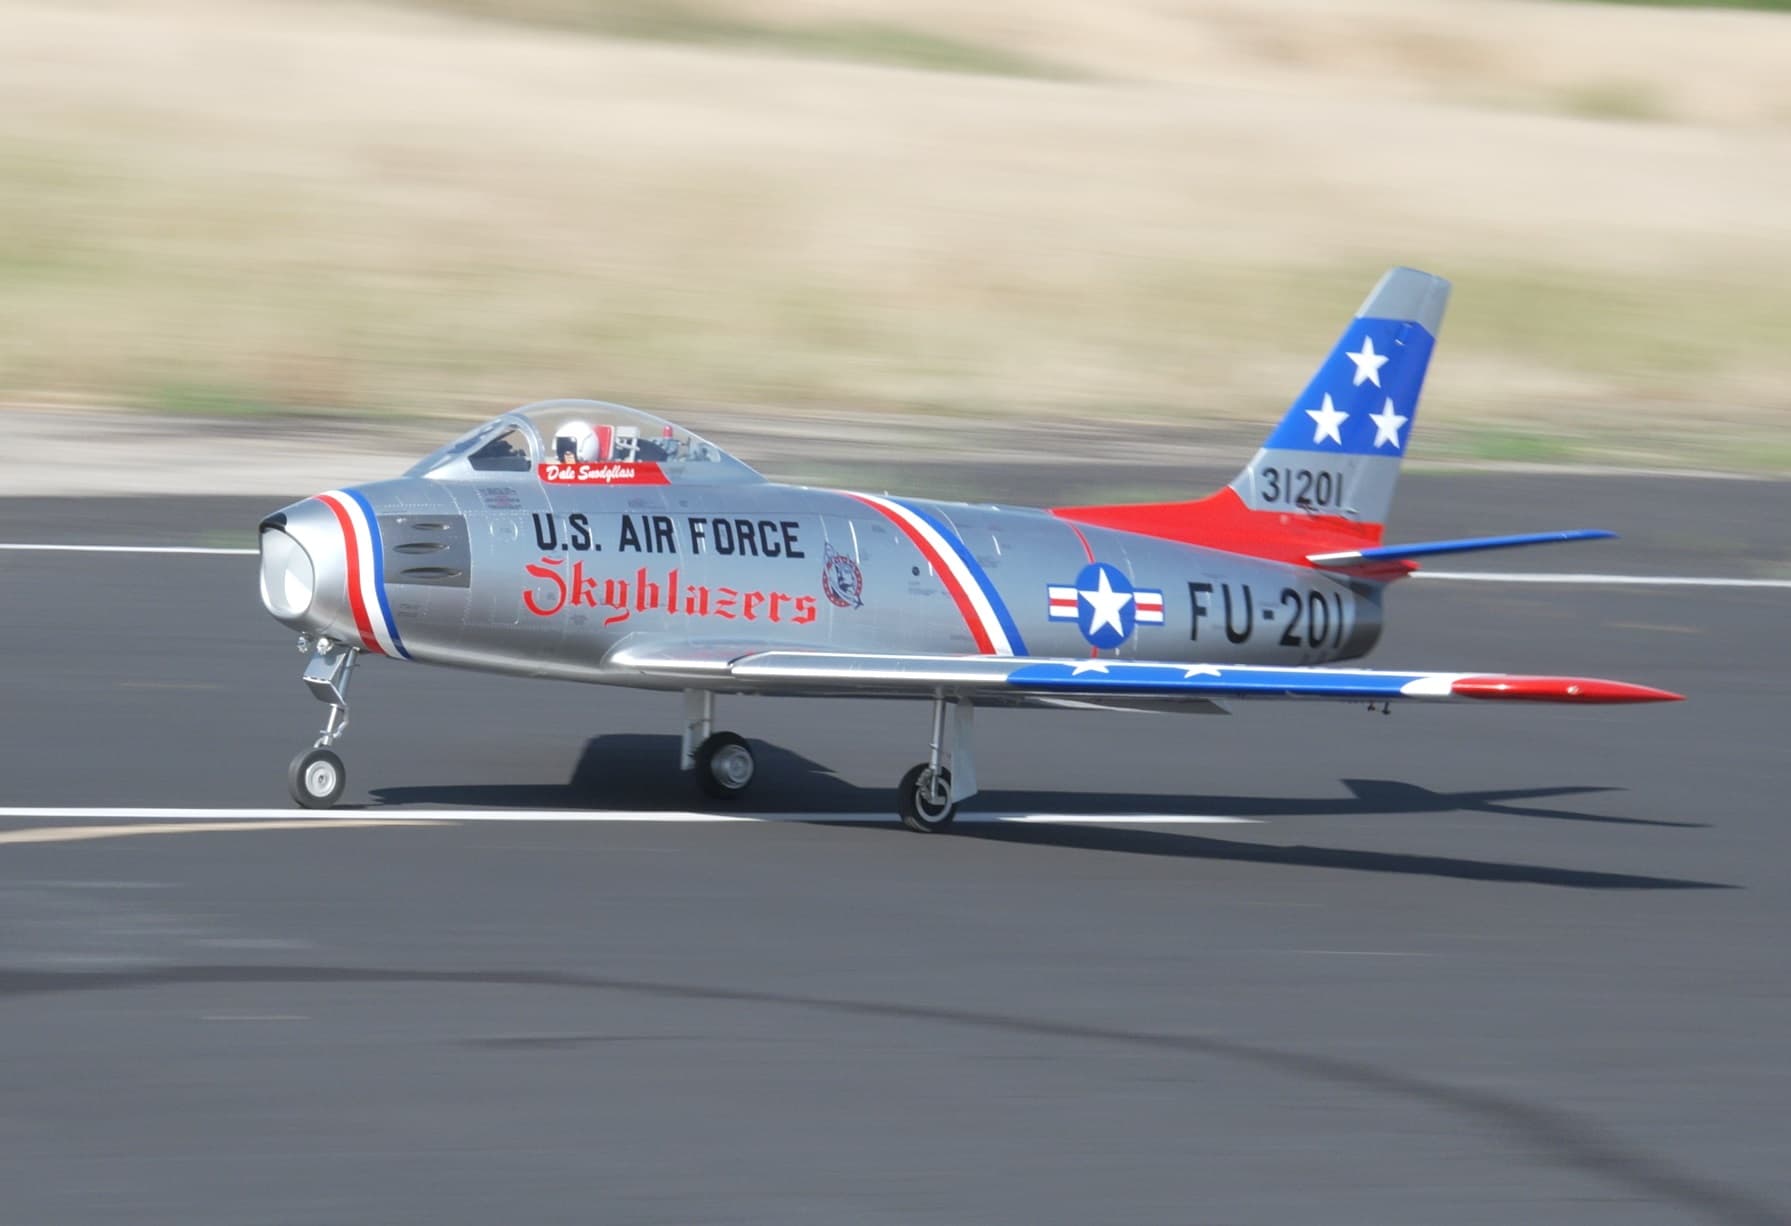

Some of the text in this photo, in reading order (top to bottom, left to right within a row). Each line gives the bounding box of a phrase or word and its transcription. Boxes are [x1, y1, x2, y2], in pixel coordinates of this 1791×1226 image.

[546, 465, 576, 481] Dale
[1261, 467, 1344, 508] 31201
[532, 513, 806, 559] U.S. AIR FORCE
[522, 557, 818, 629] Skyblazers
[1187, 581, 1344, 649] FU-201
